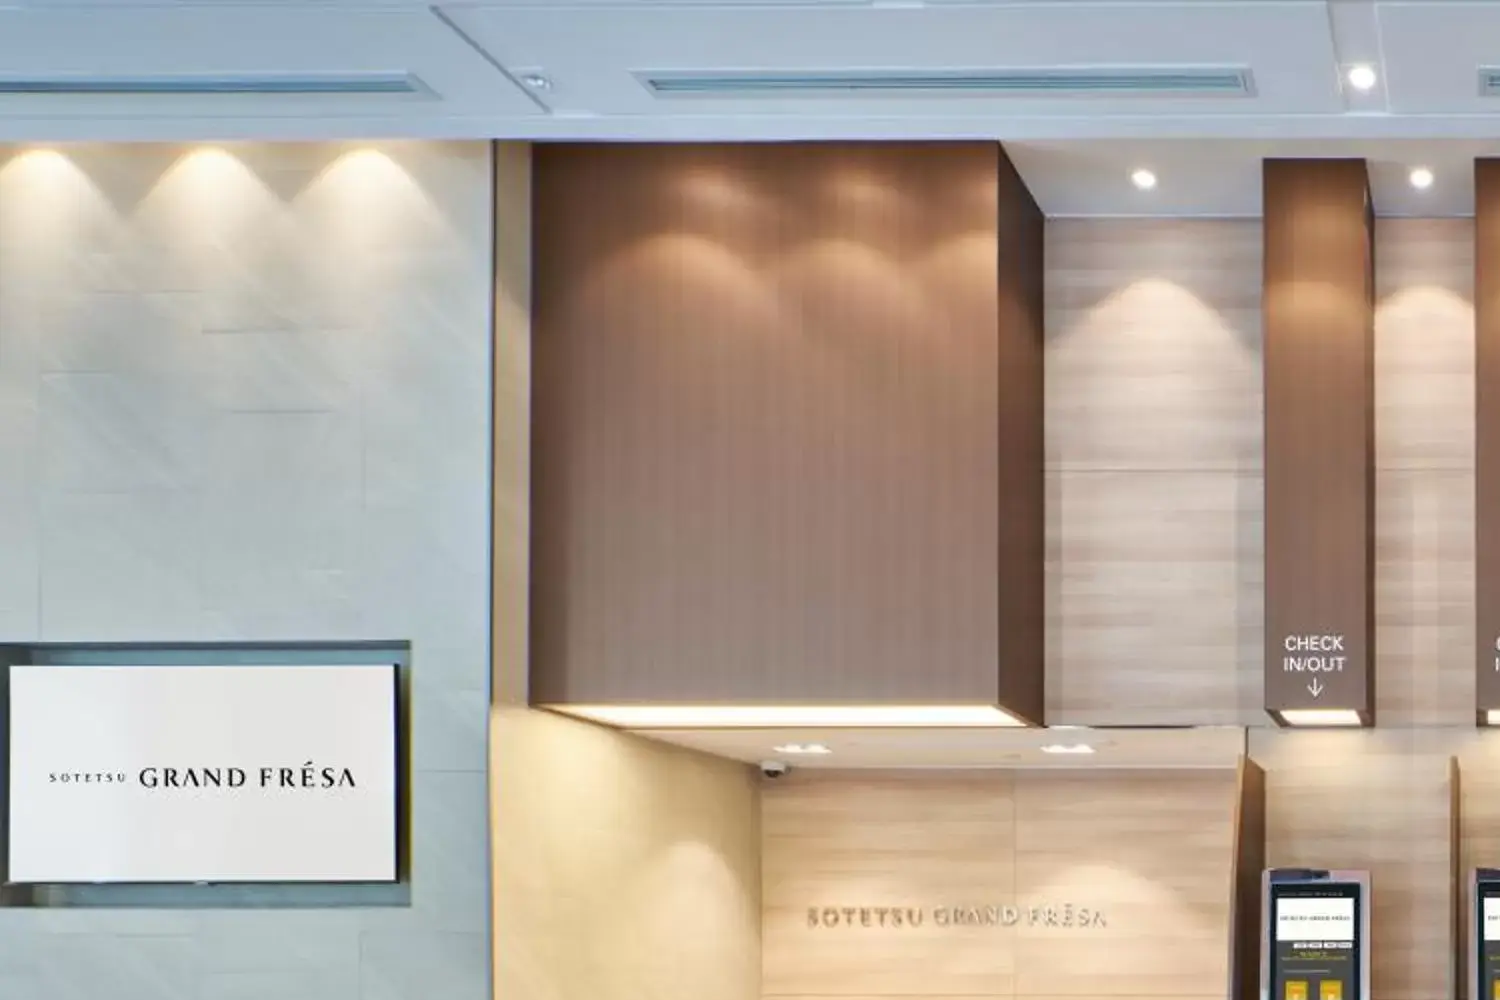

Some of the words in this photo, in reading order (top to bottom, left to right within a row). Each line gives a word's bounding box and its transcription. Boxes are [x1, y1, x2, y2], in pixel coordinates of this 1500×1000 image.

[1284, 635, 1344, 652] CHECK
[1283, 655, 1346, 672] IN/OUT
[48, 771, 127, 783] SOTETSU
[138, 767, 247, 788] GRAND
[259, 760, 357, 788] FRÉSA
[806, 906, 924, 928] SOTETSU
[933, 904, 1021, 927] GRAND
